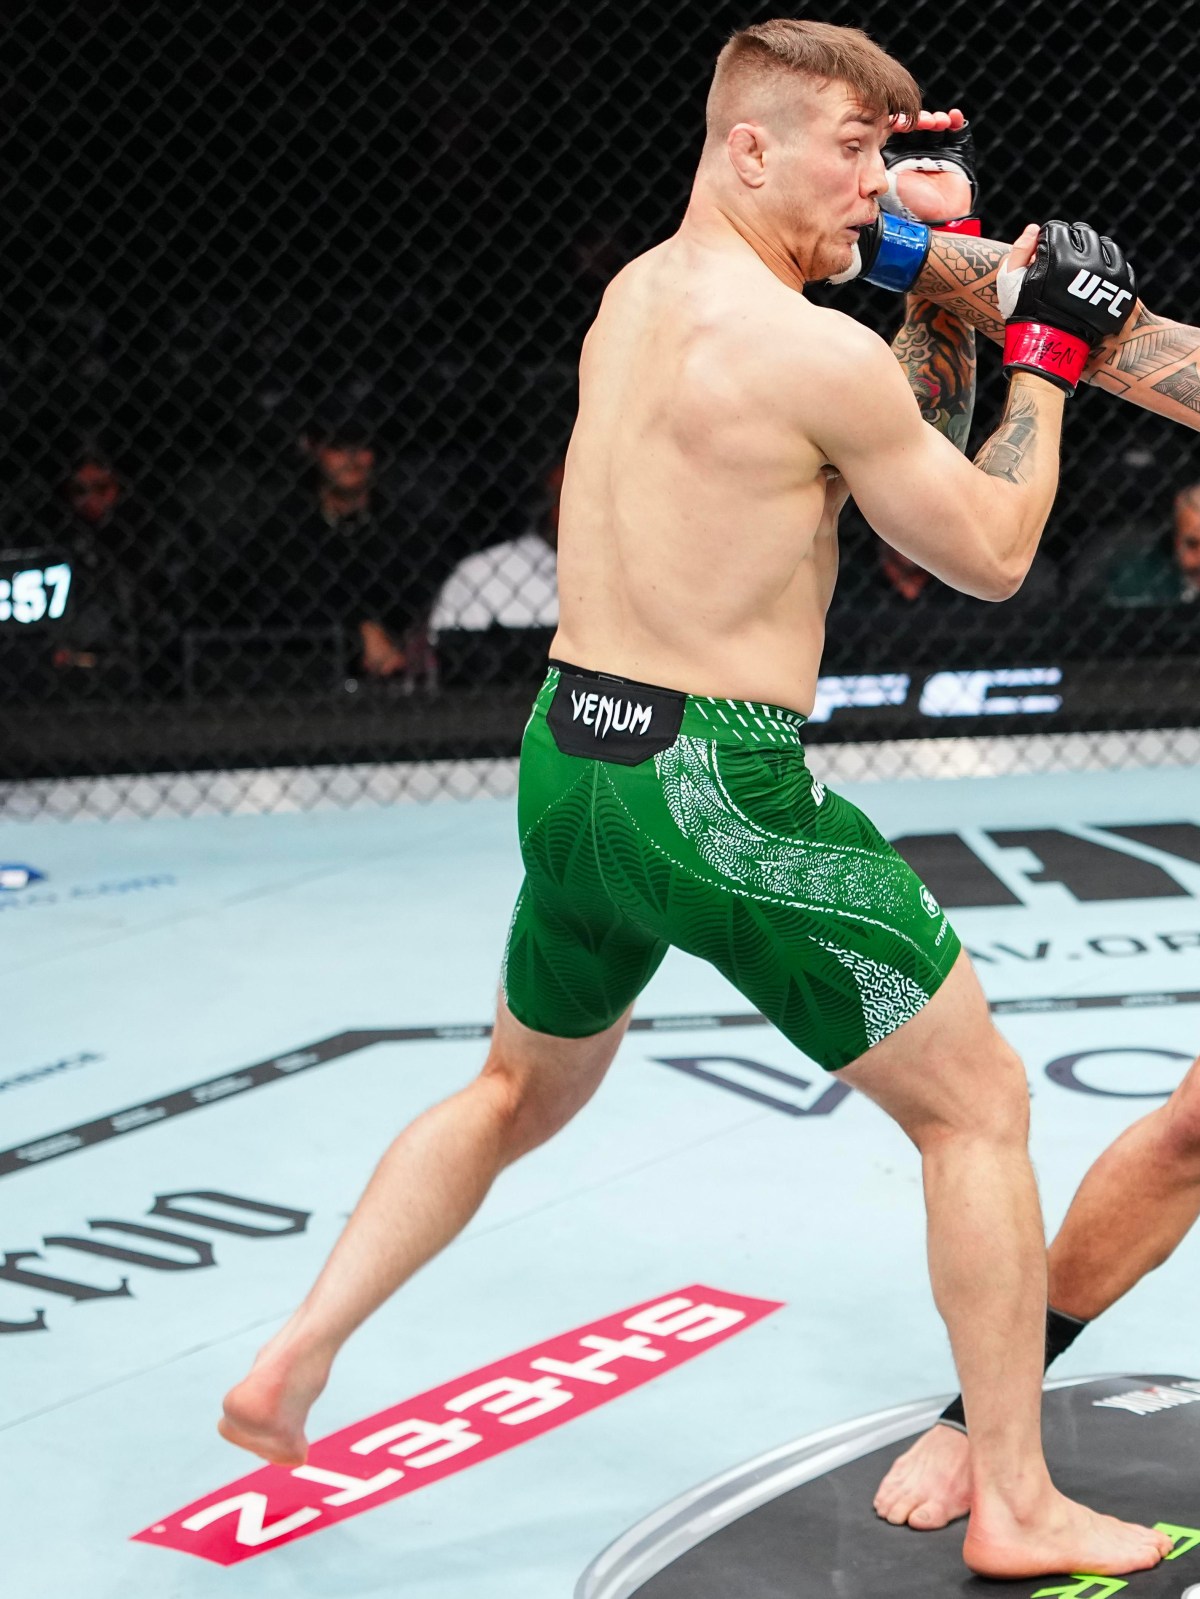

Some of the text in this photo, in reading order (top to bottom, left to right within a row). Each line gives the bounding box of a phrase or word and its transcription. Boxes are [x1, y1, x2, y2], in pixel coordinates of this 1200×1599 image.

[1067, 268, 1132, 318] UFC
[571, 689, 653, 739] VENUM
[181, 1297, 746, 1547] SHEETZ
